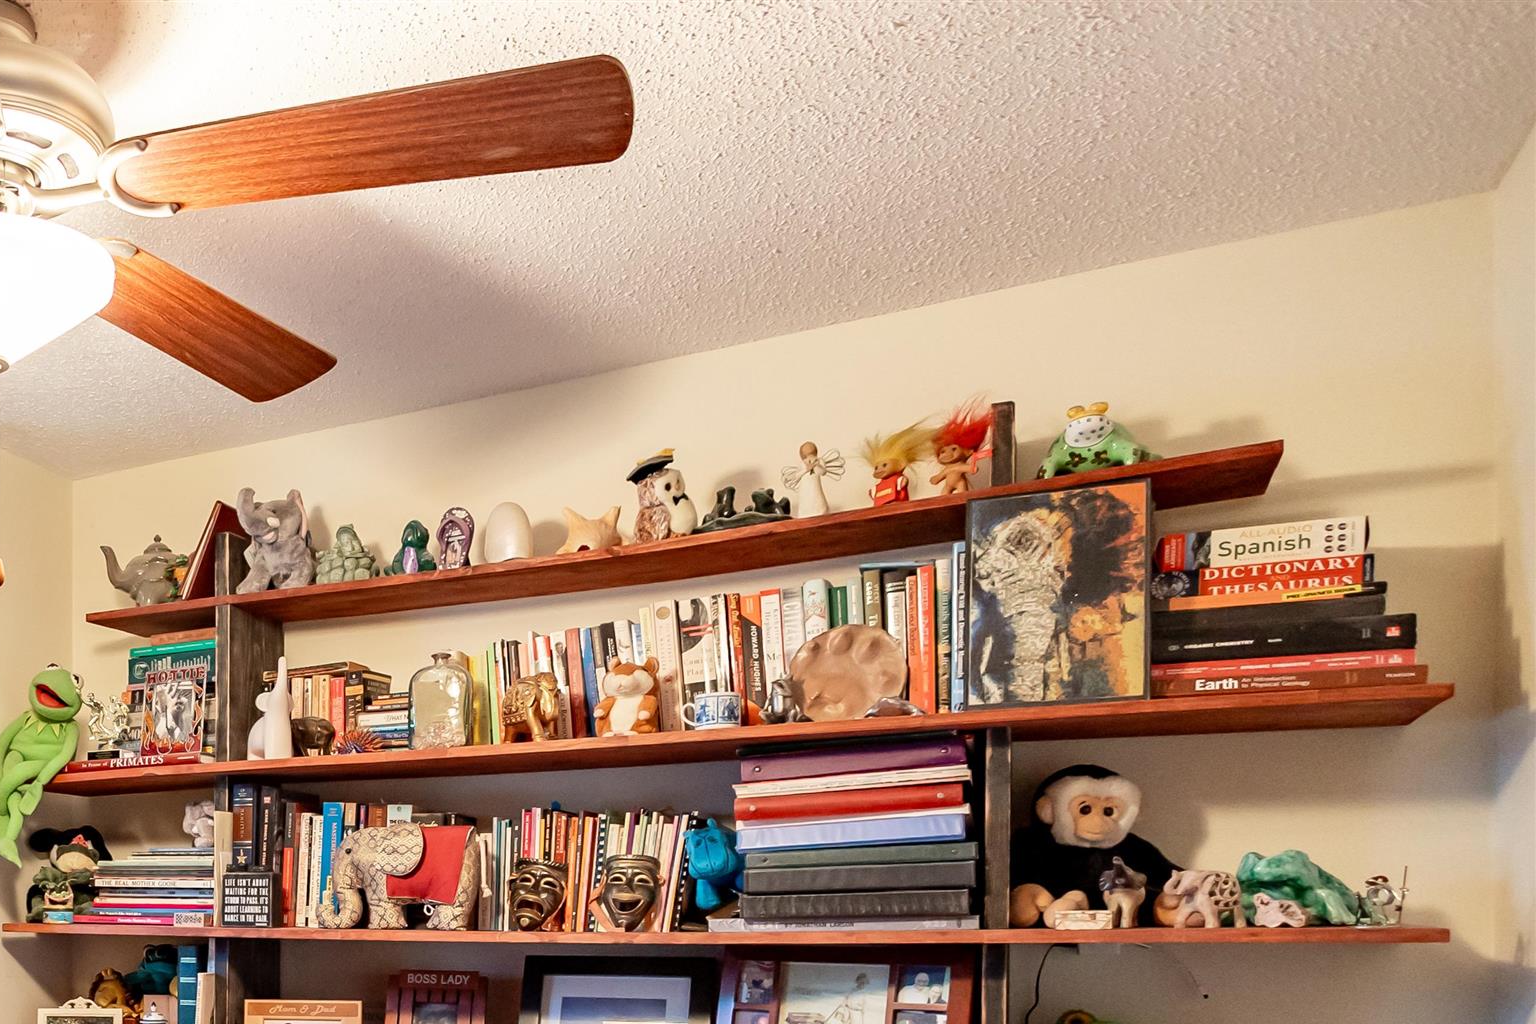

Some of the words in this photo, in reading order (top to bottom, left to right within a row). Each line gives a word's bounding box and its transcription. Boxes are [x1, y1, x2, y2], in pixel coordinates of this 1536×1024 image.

[1218, 533, 1312, 560] Spanish
[1204, 556, 1360, 581] DICTIONARY
[1208, 575, 1354, 596] THESAURUS
[868, 614, 878, 626] Th
[750, 625, 758, 659] HOWARD
[145, 665, 206, 685] HOTTIE
[753, 661, 761, 692] HUGHES
[1195, 678, 1239, 691] Earth
[110, 755, 164, 768] PRIMATES
[252, 878, 269, 886] ABOUT
[224, 914, 239, 922] DANCE
[407, 973, 437, 984] BOSS
[440, 974, 470, 985] LADY
[269, 1004, 297, 1014] Mom
[310, 1004, 337, 1016] Dad
